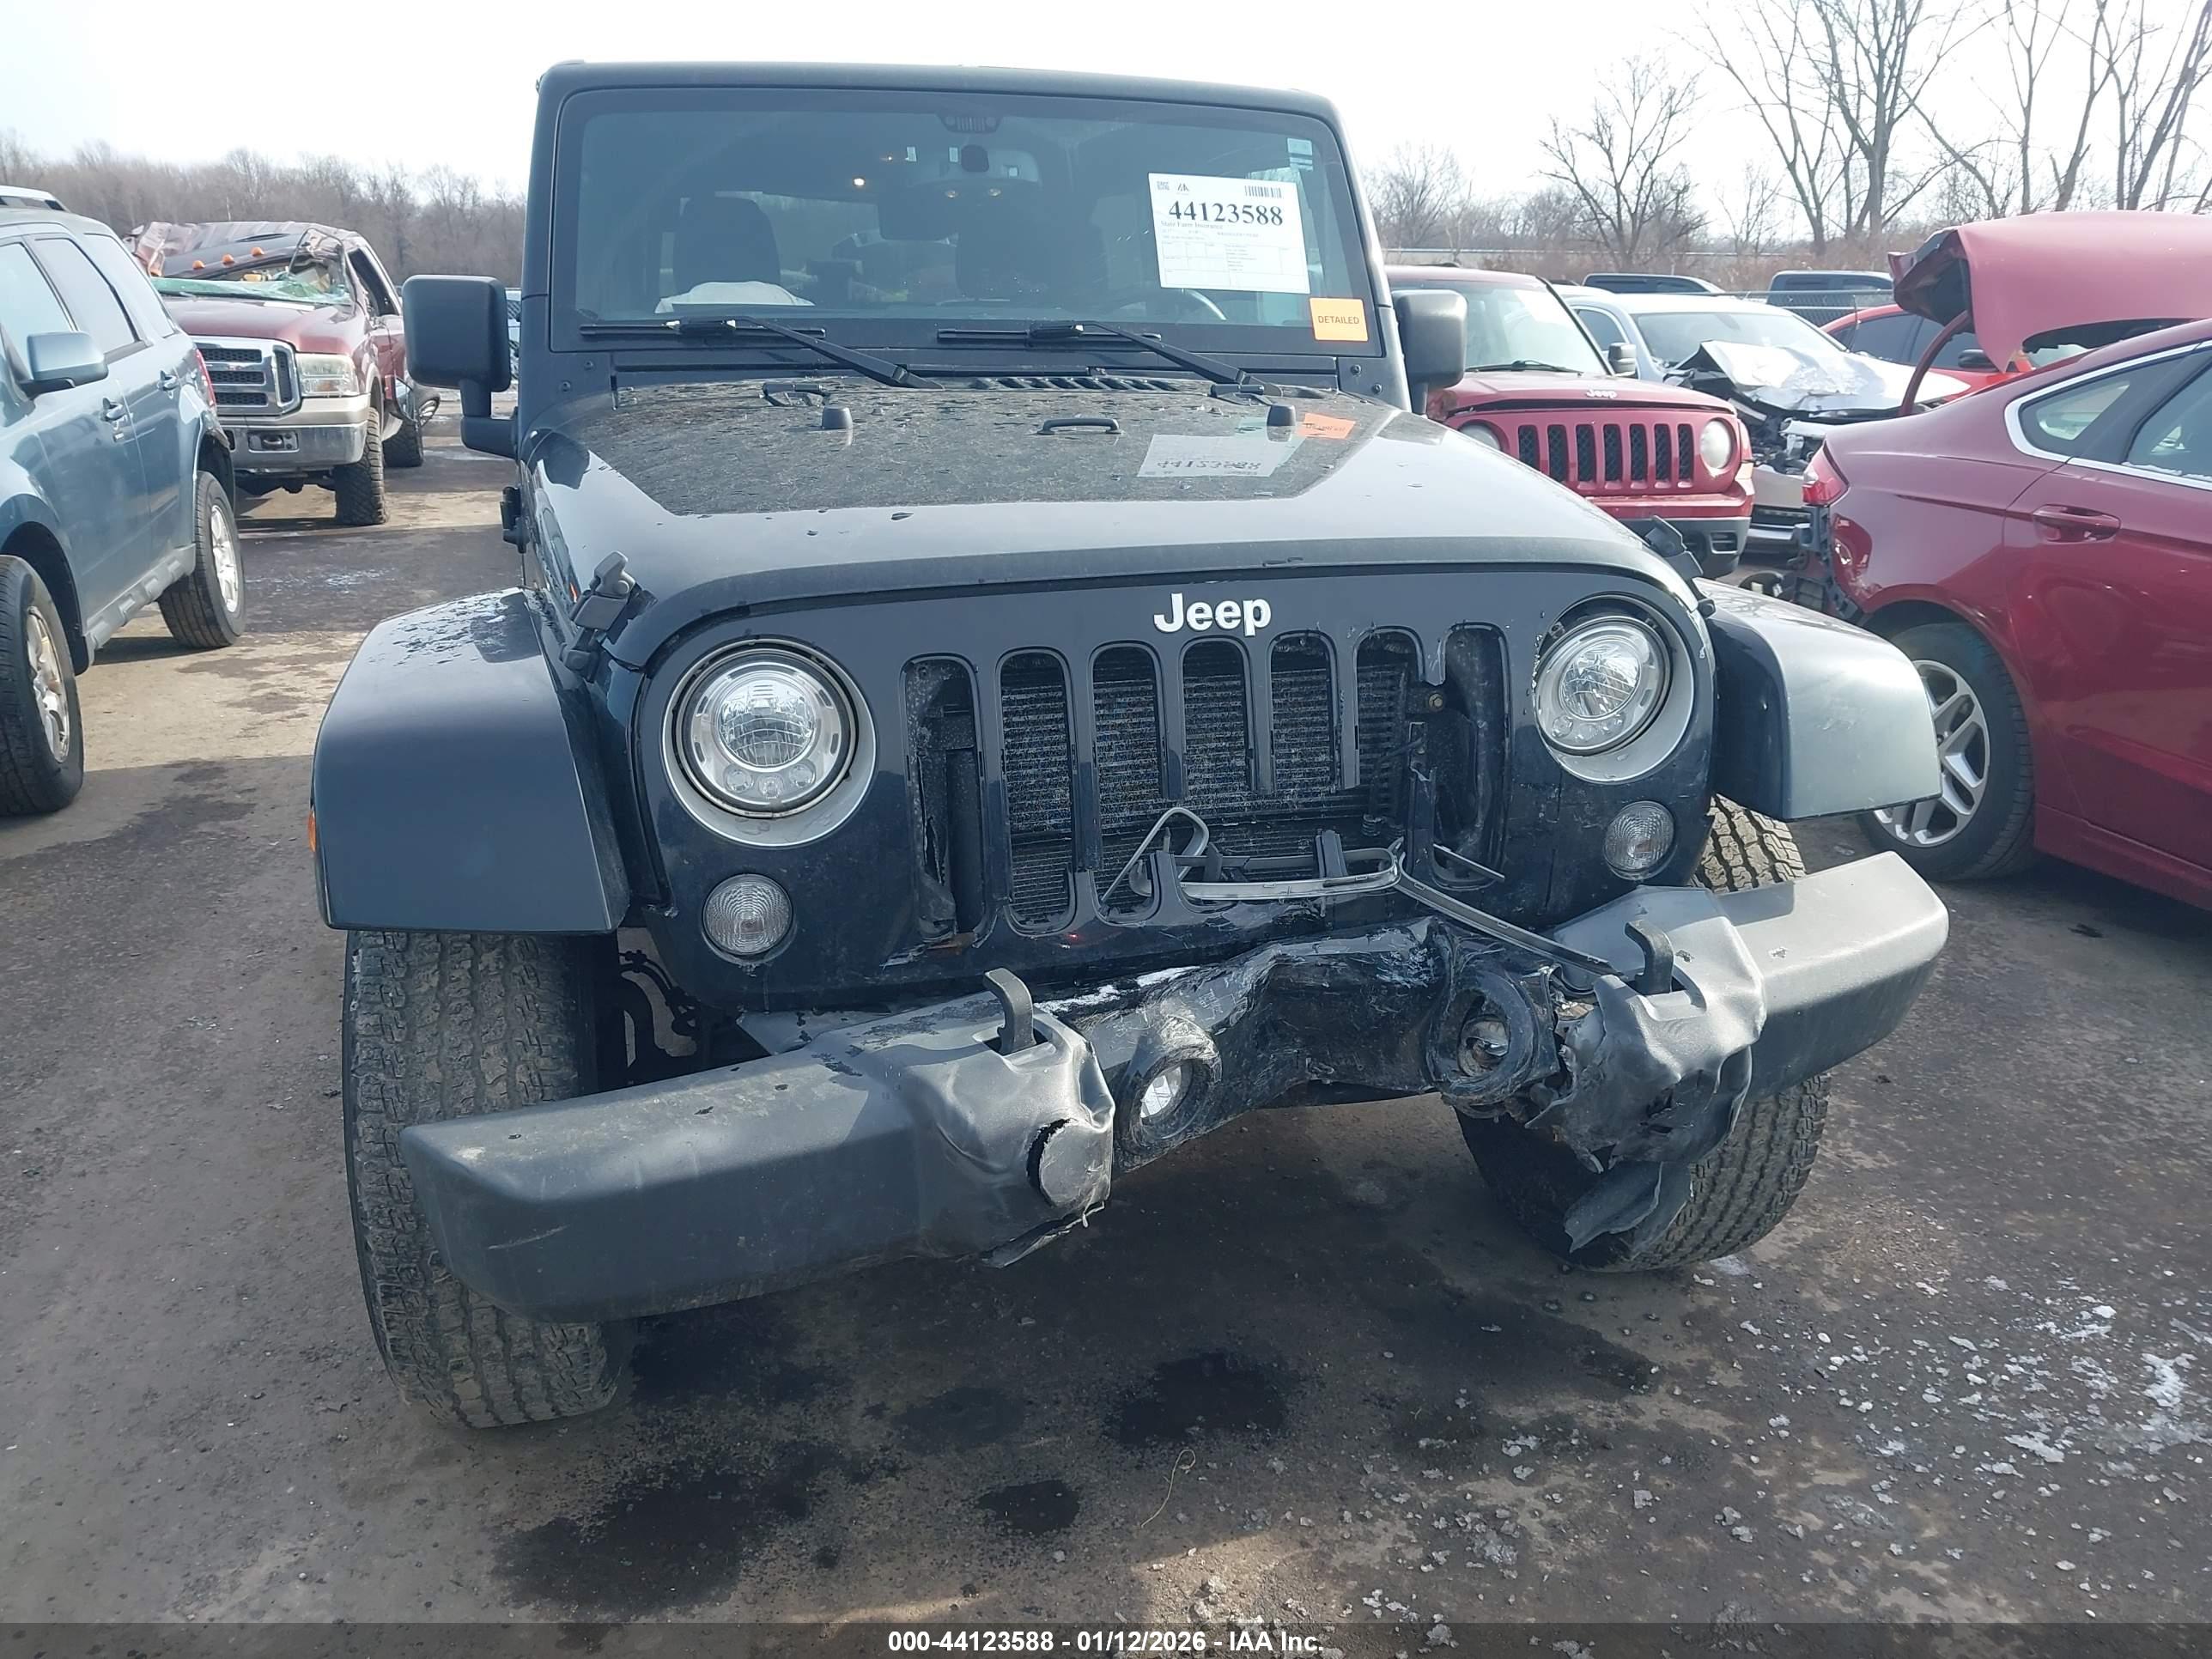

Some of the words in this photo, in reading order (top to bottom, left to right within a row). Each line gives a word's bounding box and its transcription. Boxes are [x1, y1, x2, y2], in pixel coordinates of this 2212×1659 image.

[1169, 200, 1284, 227] 44123588
[1317, 315, 1360, 325] DETAILED
[1153, 592, 1272, 638] Jeep
